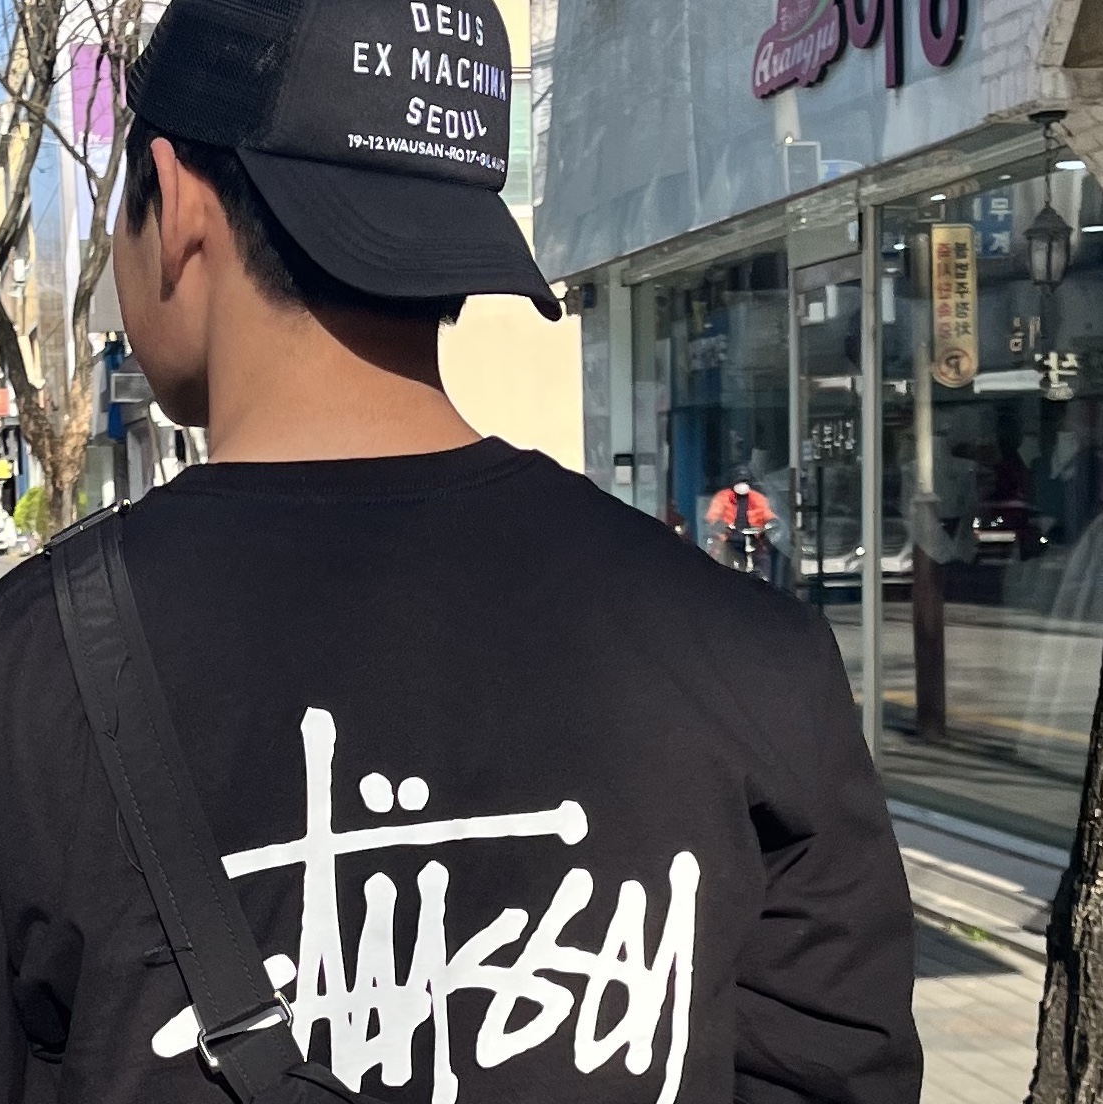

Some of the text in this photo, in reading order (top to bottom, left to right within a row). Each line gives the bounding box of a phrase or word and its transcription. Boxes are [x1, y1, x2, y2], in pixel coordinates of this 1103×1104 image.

[410, 2, 484, 46] DEUS
[353, 41, 507, 101] EX MACHINA
[405, 96, 488, 140] SEOUL
[347, 133, 385, 151] 19-12
